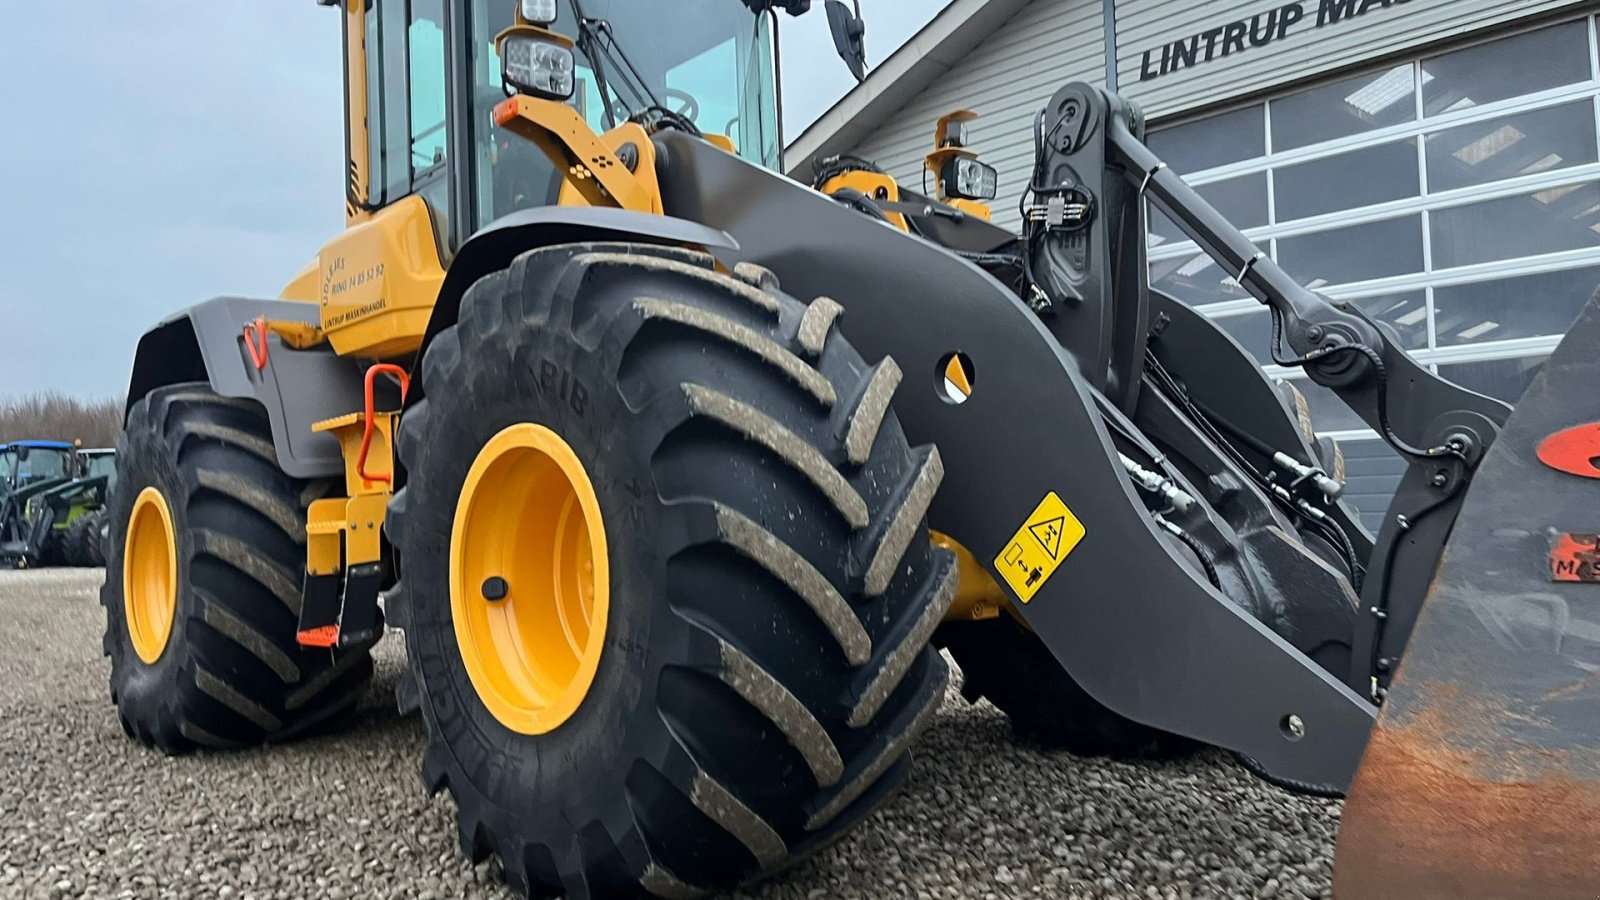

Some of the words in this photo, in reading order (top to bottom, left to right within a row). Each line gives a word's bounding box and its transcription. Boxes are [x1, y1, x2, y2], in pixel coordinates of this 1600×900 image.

[1139, 3, 1303, 81] LINTRUP
[332, 279, 347, 296] RING
[375, 263, 384, 278] 92
[324, 313, 345, 329] LINTRUP
[345, 298, 386, 320] MASKINHANDEL
